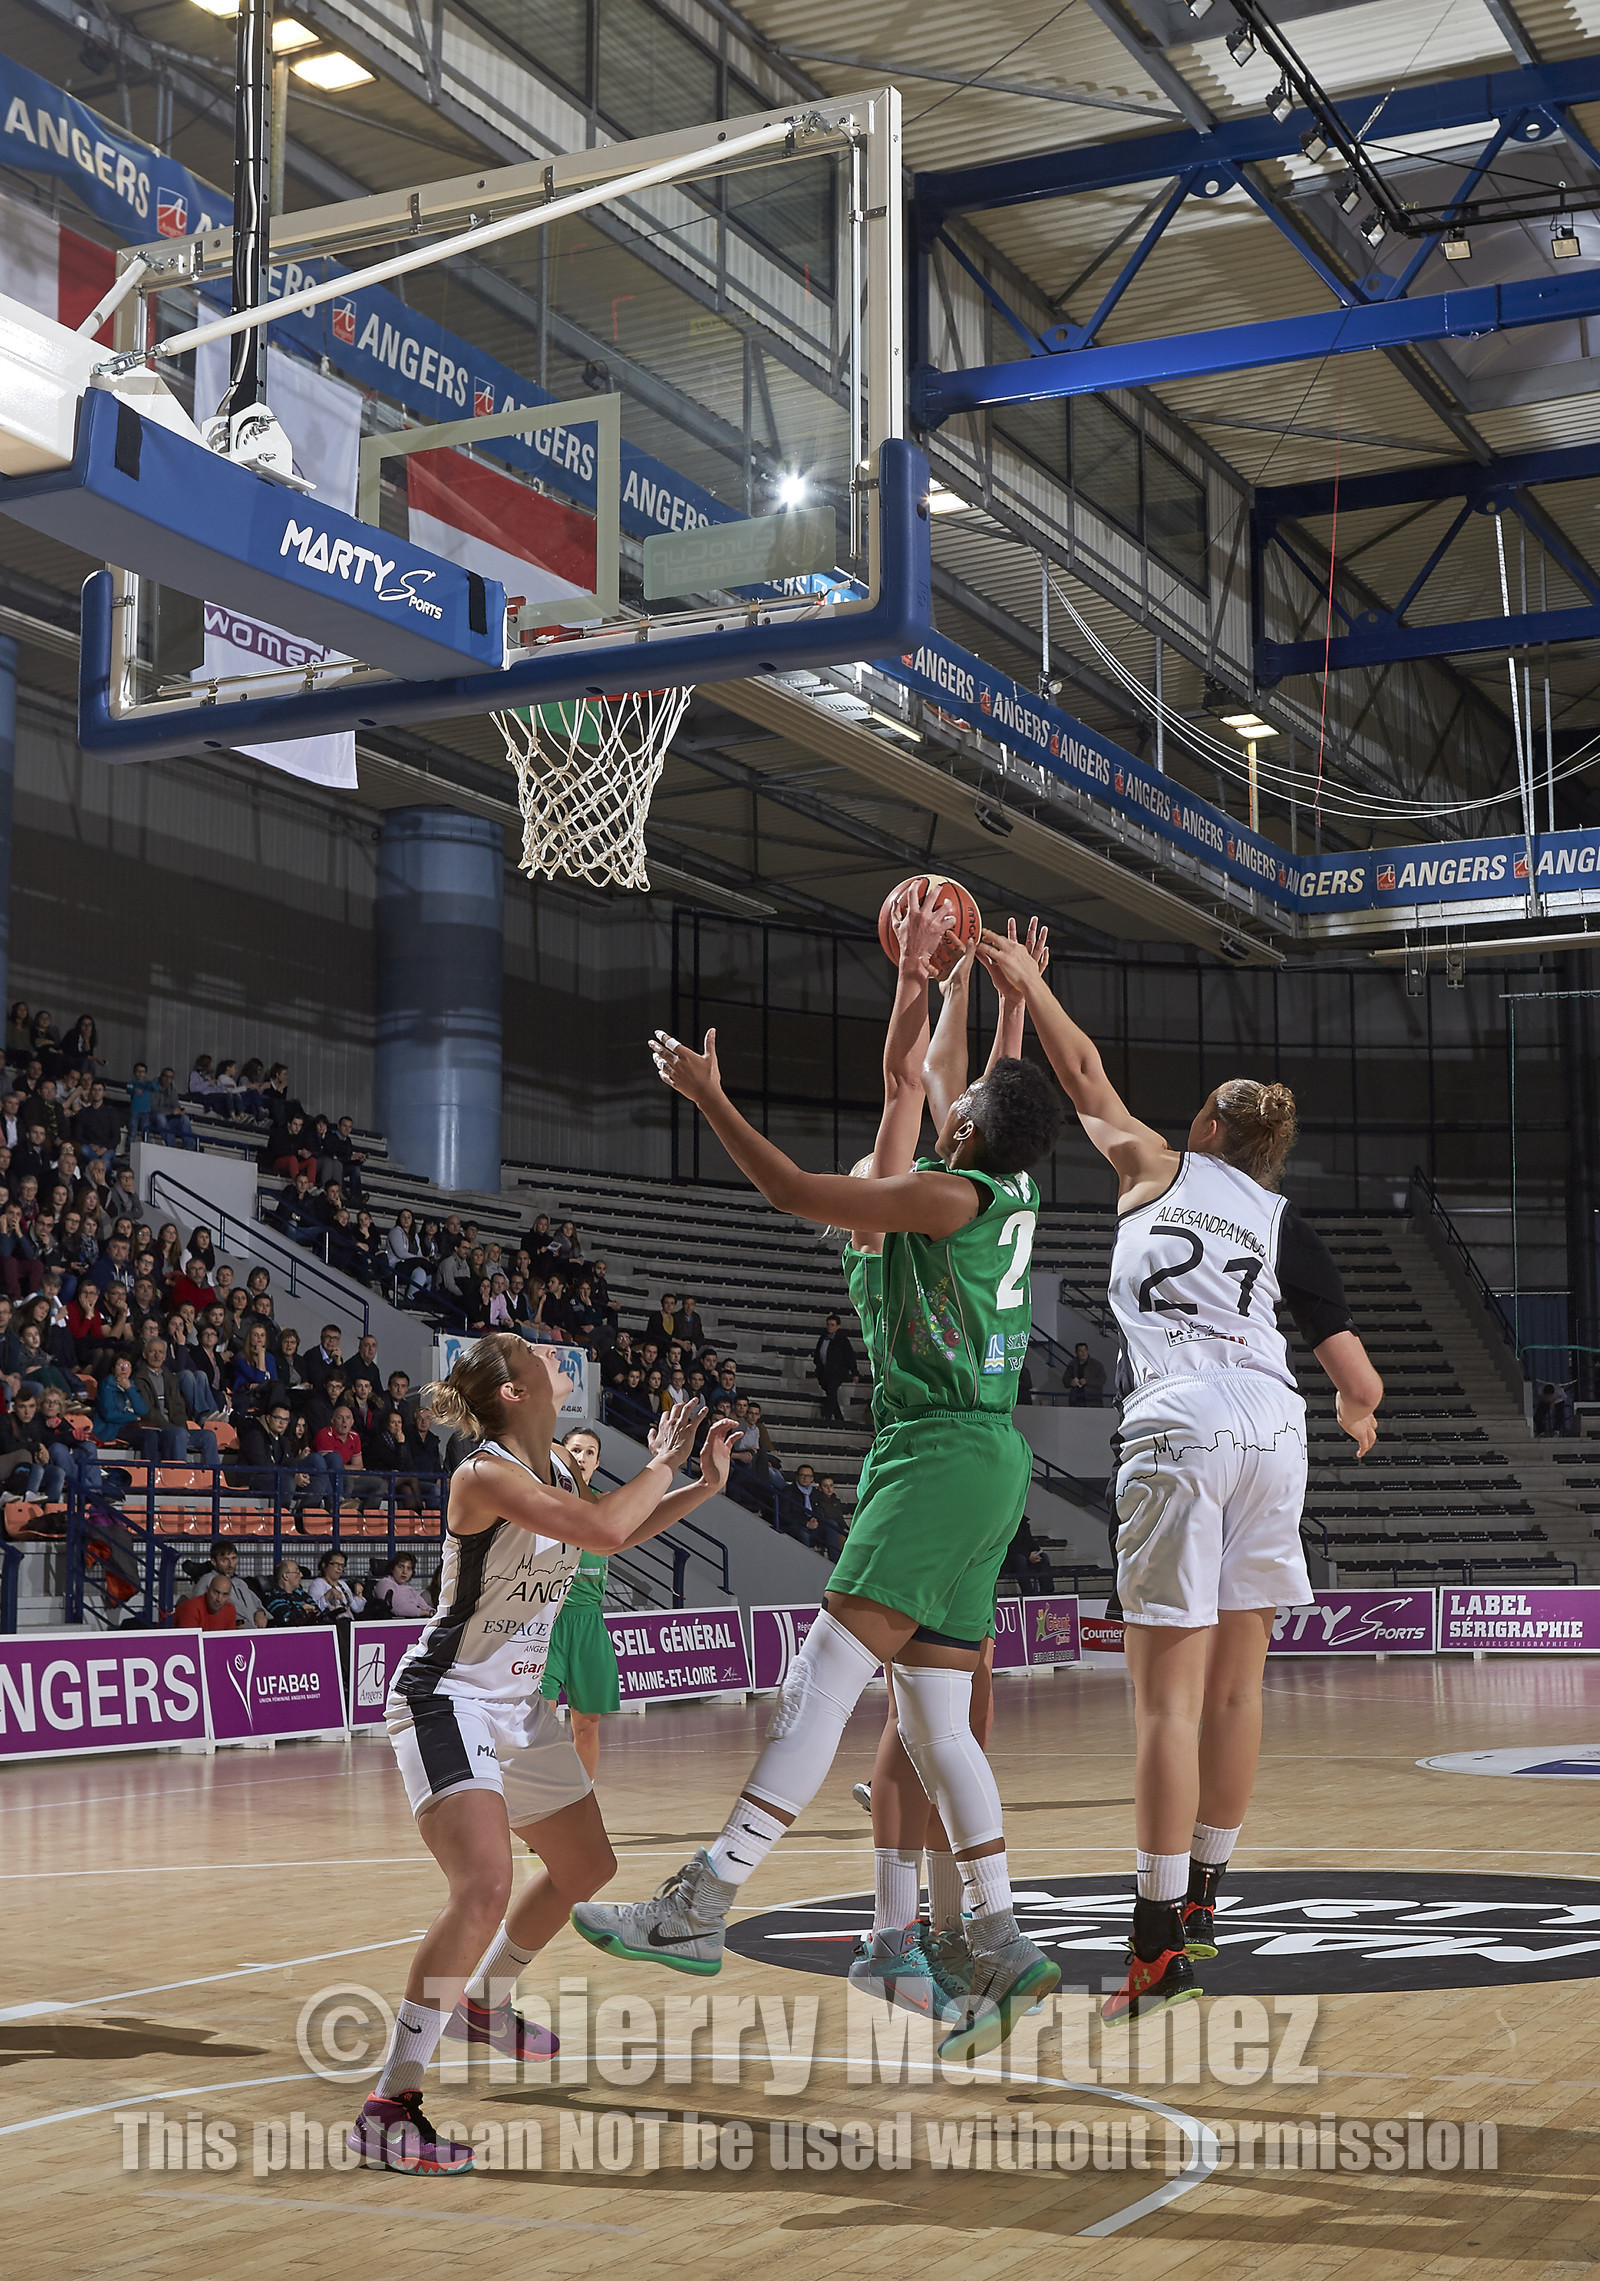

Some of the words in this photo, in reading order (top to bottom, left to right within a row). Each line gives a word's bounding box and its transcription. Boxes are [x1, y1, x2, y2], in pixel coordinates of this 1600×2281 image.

[5, 97, 150, 218] ANGERS
[357, 312, 468, 406] ANGERS
[279, 519, 395, 592] MARTY
[378, 570, 443, 620] SPORTS
[914, 646, 974, 703] ANGERS
[992, 692, 1050, 748] ANGERS
[1060, 734, 1110, 785] ANGERS
[1125, 773, 1171, 822] ANGERS
[1182, 807, 1224, 852] ANGERS
[1236, 839, 1277, 882] ANGERS
[1286, 867, 1366, 897] ANGERS
[1398, 854, 1507, 888] ANGERS
[1535, 846, 1600, 875] ANG
[995, 1210, 1037, 1310] 2
[1139, 1226, 1263, 1317] 21
[1451, 1595, 1532, 1615] LABEL
[482, 1620, 549, 1637] ESPACE
[608, 1628, 656, 1657] SEIL
[659, 1618, 736, 1652] GÉNÉRAL
[1080, 1627, 1124, 1641] Courrier
[1449, 1617, 1583, 1638] SÉRIGRAPHIE
[0, 1655, 199, 1734] NGERS
[256, 1673, 320, 1695] UFAB49
[626, 1665, 718, 1692] MAINE-ET-LOIRE
